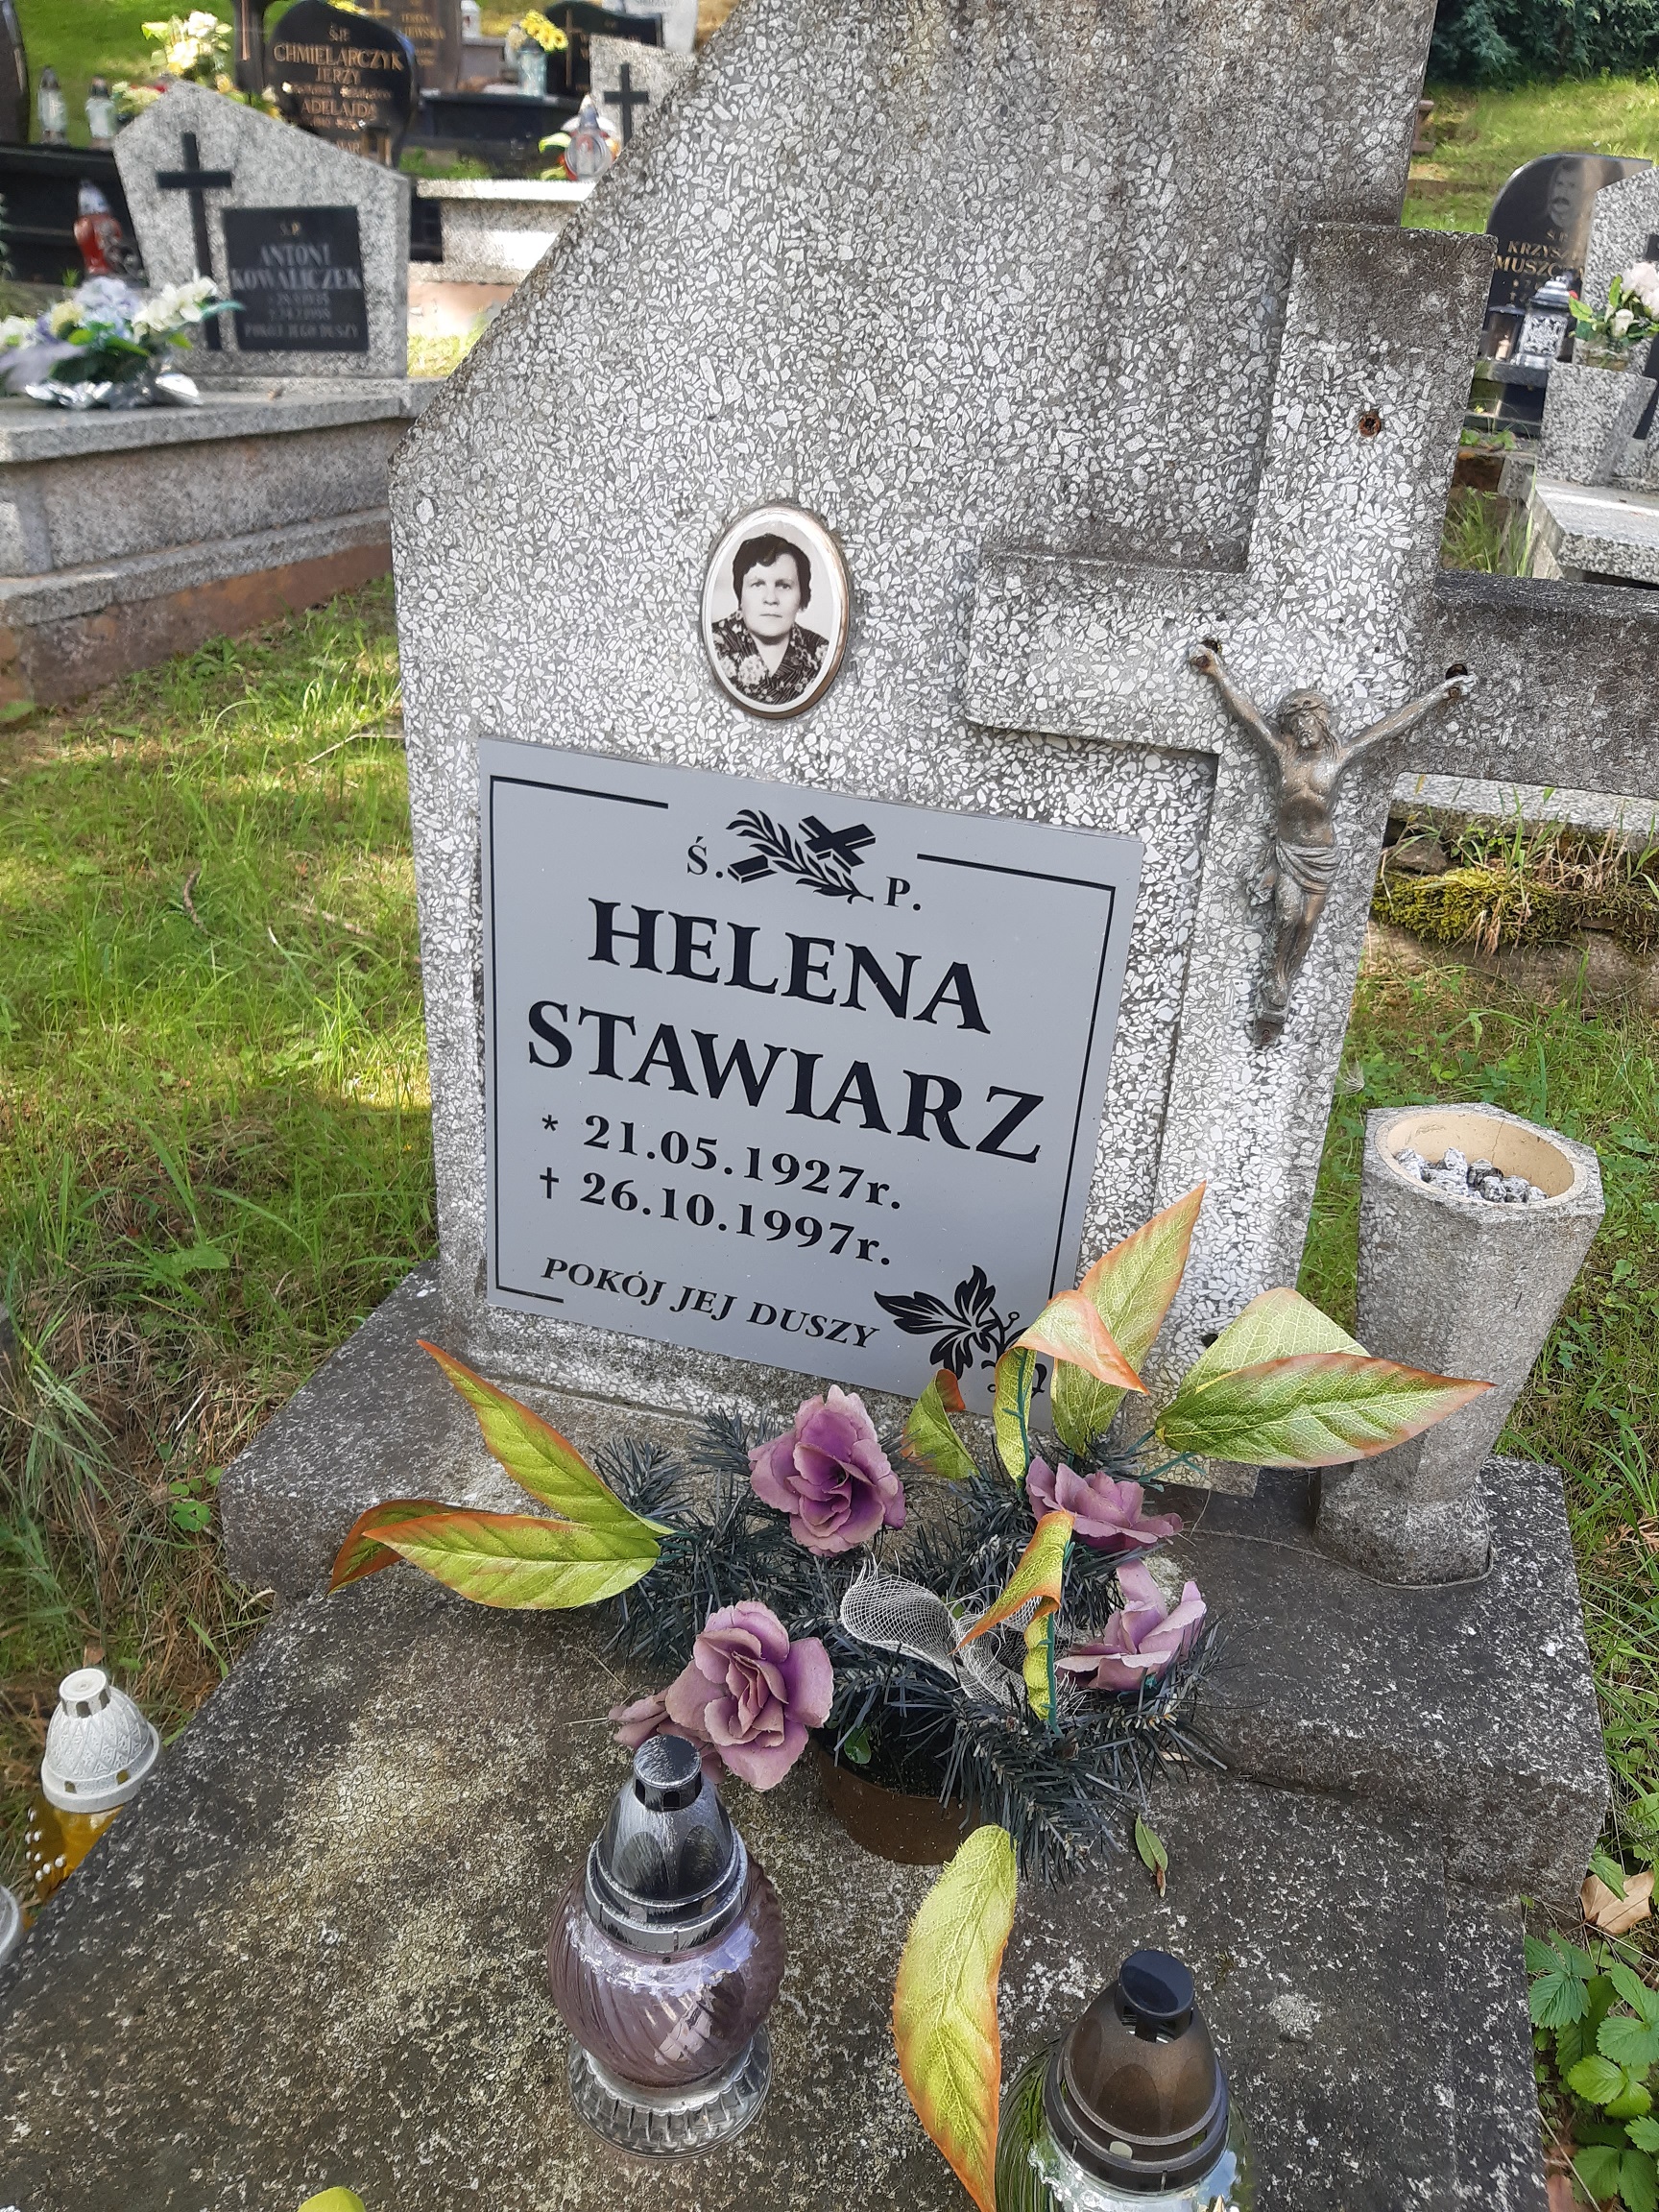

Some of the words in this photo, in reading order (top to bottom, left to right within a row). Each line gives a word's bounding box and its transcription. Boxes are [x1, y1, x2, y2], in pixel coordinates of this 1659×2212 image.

[273, 43, 405, 72] CHMIELARCZYK
[315, 65, 362, 85] JERZY
[260, 242, 331, 267] ANTONI
[686, 835, 724, 879] Ś.
[883, 875, 922, 912] P.
[587, 897, 992, 1035] HELENA
[527, 998, 1046, 1165] STAWIARZ
[583, 1114, 902, 1210] 21.05.1927r.
[579, 1171, 892, 1266] 26.10.1997r.
[540, 1256, 667, 1307] POKÓJ
[669, 1286, 738, 1322] JEJ
[746, 1300, 880, 1349] DUSZY
